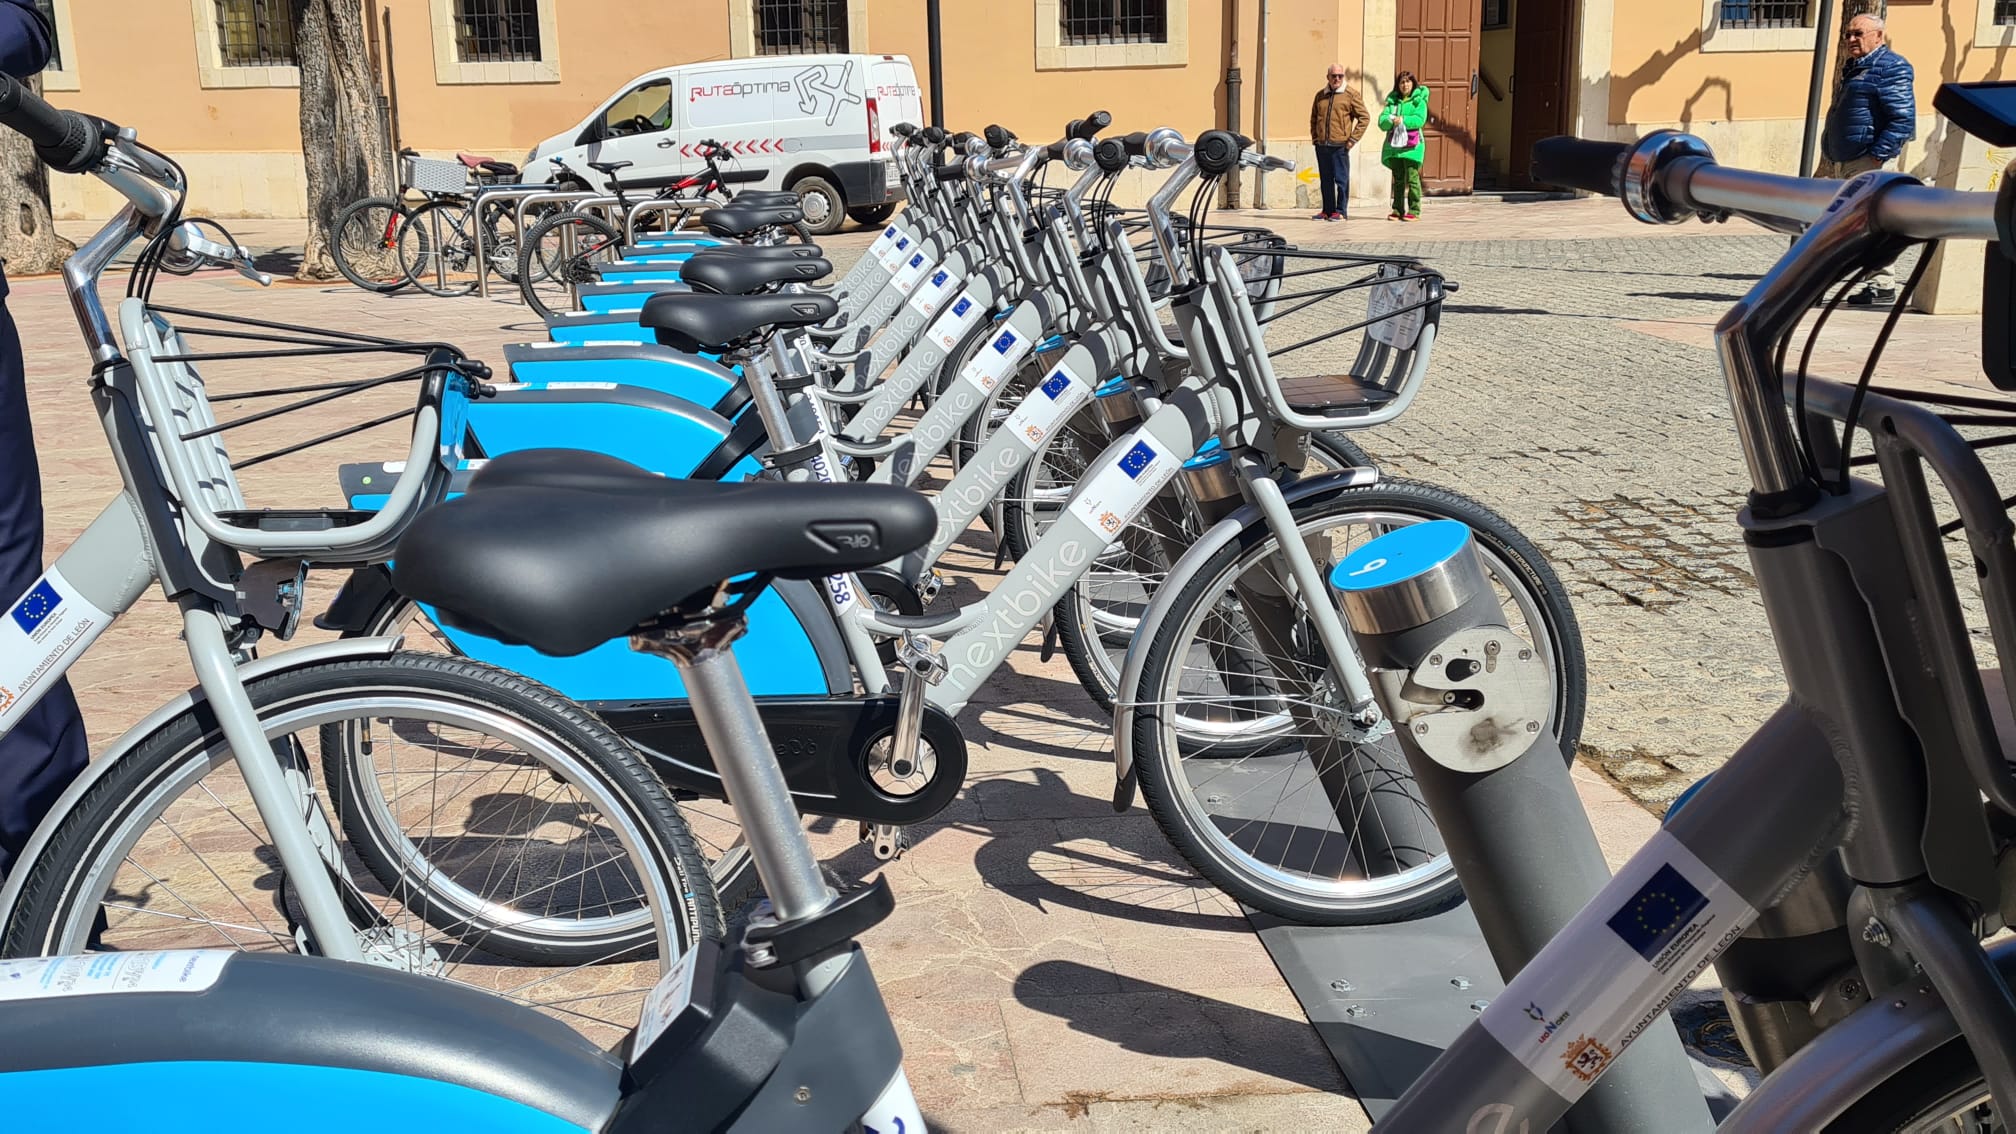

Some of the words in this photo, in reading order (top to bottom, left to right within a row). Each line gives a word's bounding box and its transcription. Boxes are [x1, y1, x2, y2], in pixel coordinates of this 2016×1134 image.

[861, 351, 938, 433] nextbike
[18, 644, 65, 692] AYUNTAMIENTO
[62, 634, 74, 646] DE
[71, 617, 91, 636] LEÓN
[947, 538, 1087, 692] nextbike
[1669, 923, 1700, 951] EUROPEA
[1619, 969, 1697, 1047] AYUNTAMIENTO
[1696, 954, 1713, 969] DE
[1712, 924, 1742, 953] LEÓN
